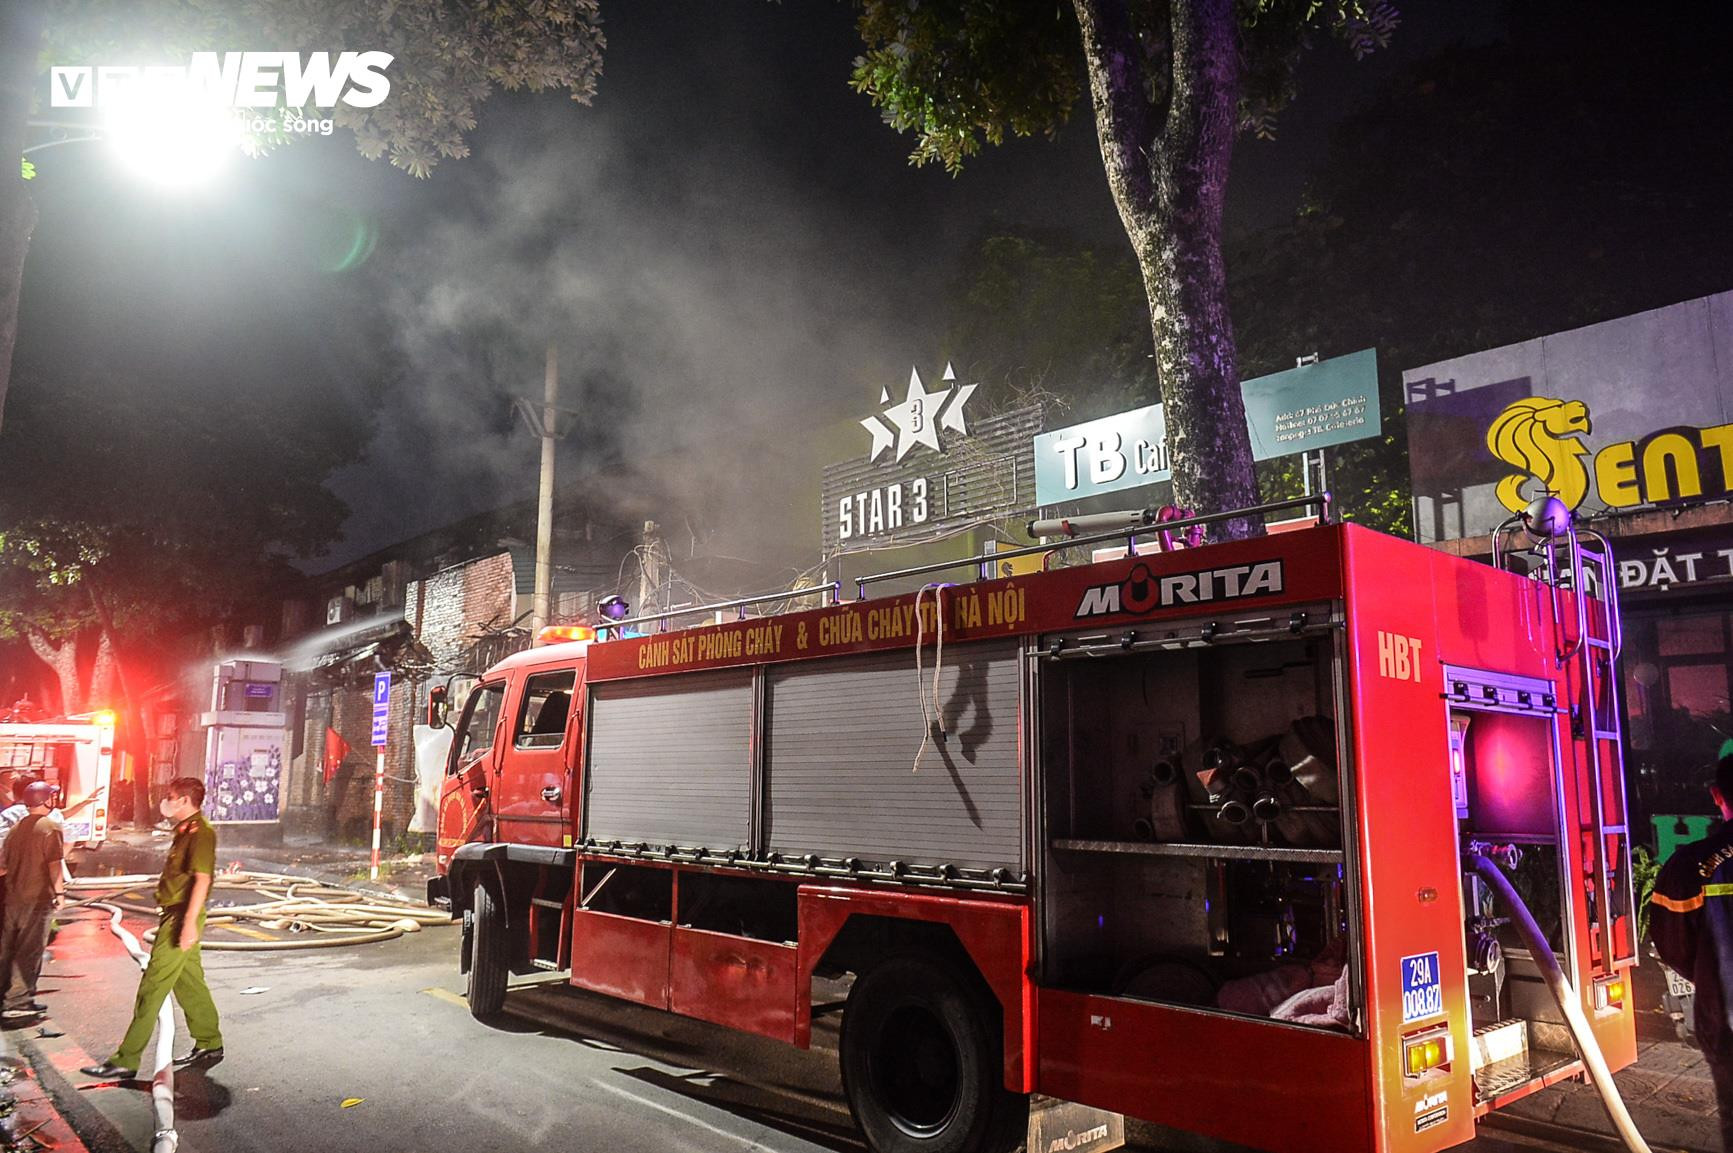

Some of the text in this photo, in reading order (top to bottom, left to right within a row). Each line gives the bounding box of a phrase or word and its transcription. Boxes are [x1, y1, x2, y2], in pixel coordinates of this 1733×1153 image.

[911, 399, 924, 433] 3
[1052, 430, 1127, 490] TB
[840, 478, 927, 539] STAR 3
[1076, 563, 1283, 616] MORITA
[1620, 547, 1704, 592] ĐẶT
[672, 631, 695, 665] SÁT
[698, 625, 742, 661] PHÒNG
[745, 619, 783, 655] CHÁY
[796, 621, 808, 650] &
[819, 606, 863, 647] CHỮA
[868, 600, 916, 641] CHÁY
[988, 581, 1025, 630] NỘI
[1378, 630, 1422, 683] HBT
[377, 681, 386, 701] P
[1410, 958, 1432, 988] 29A
